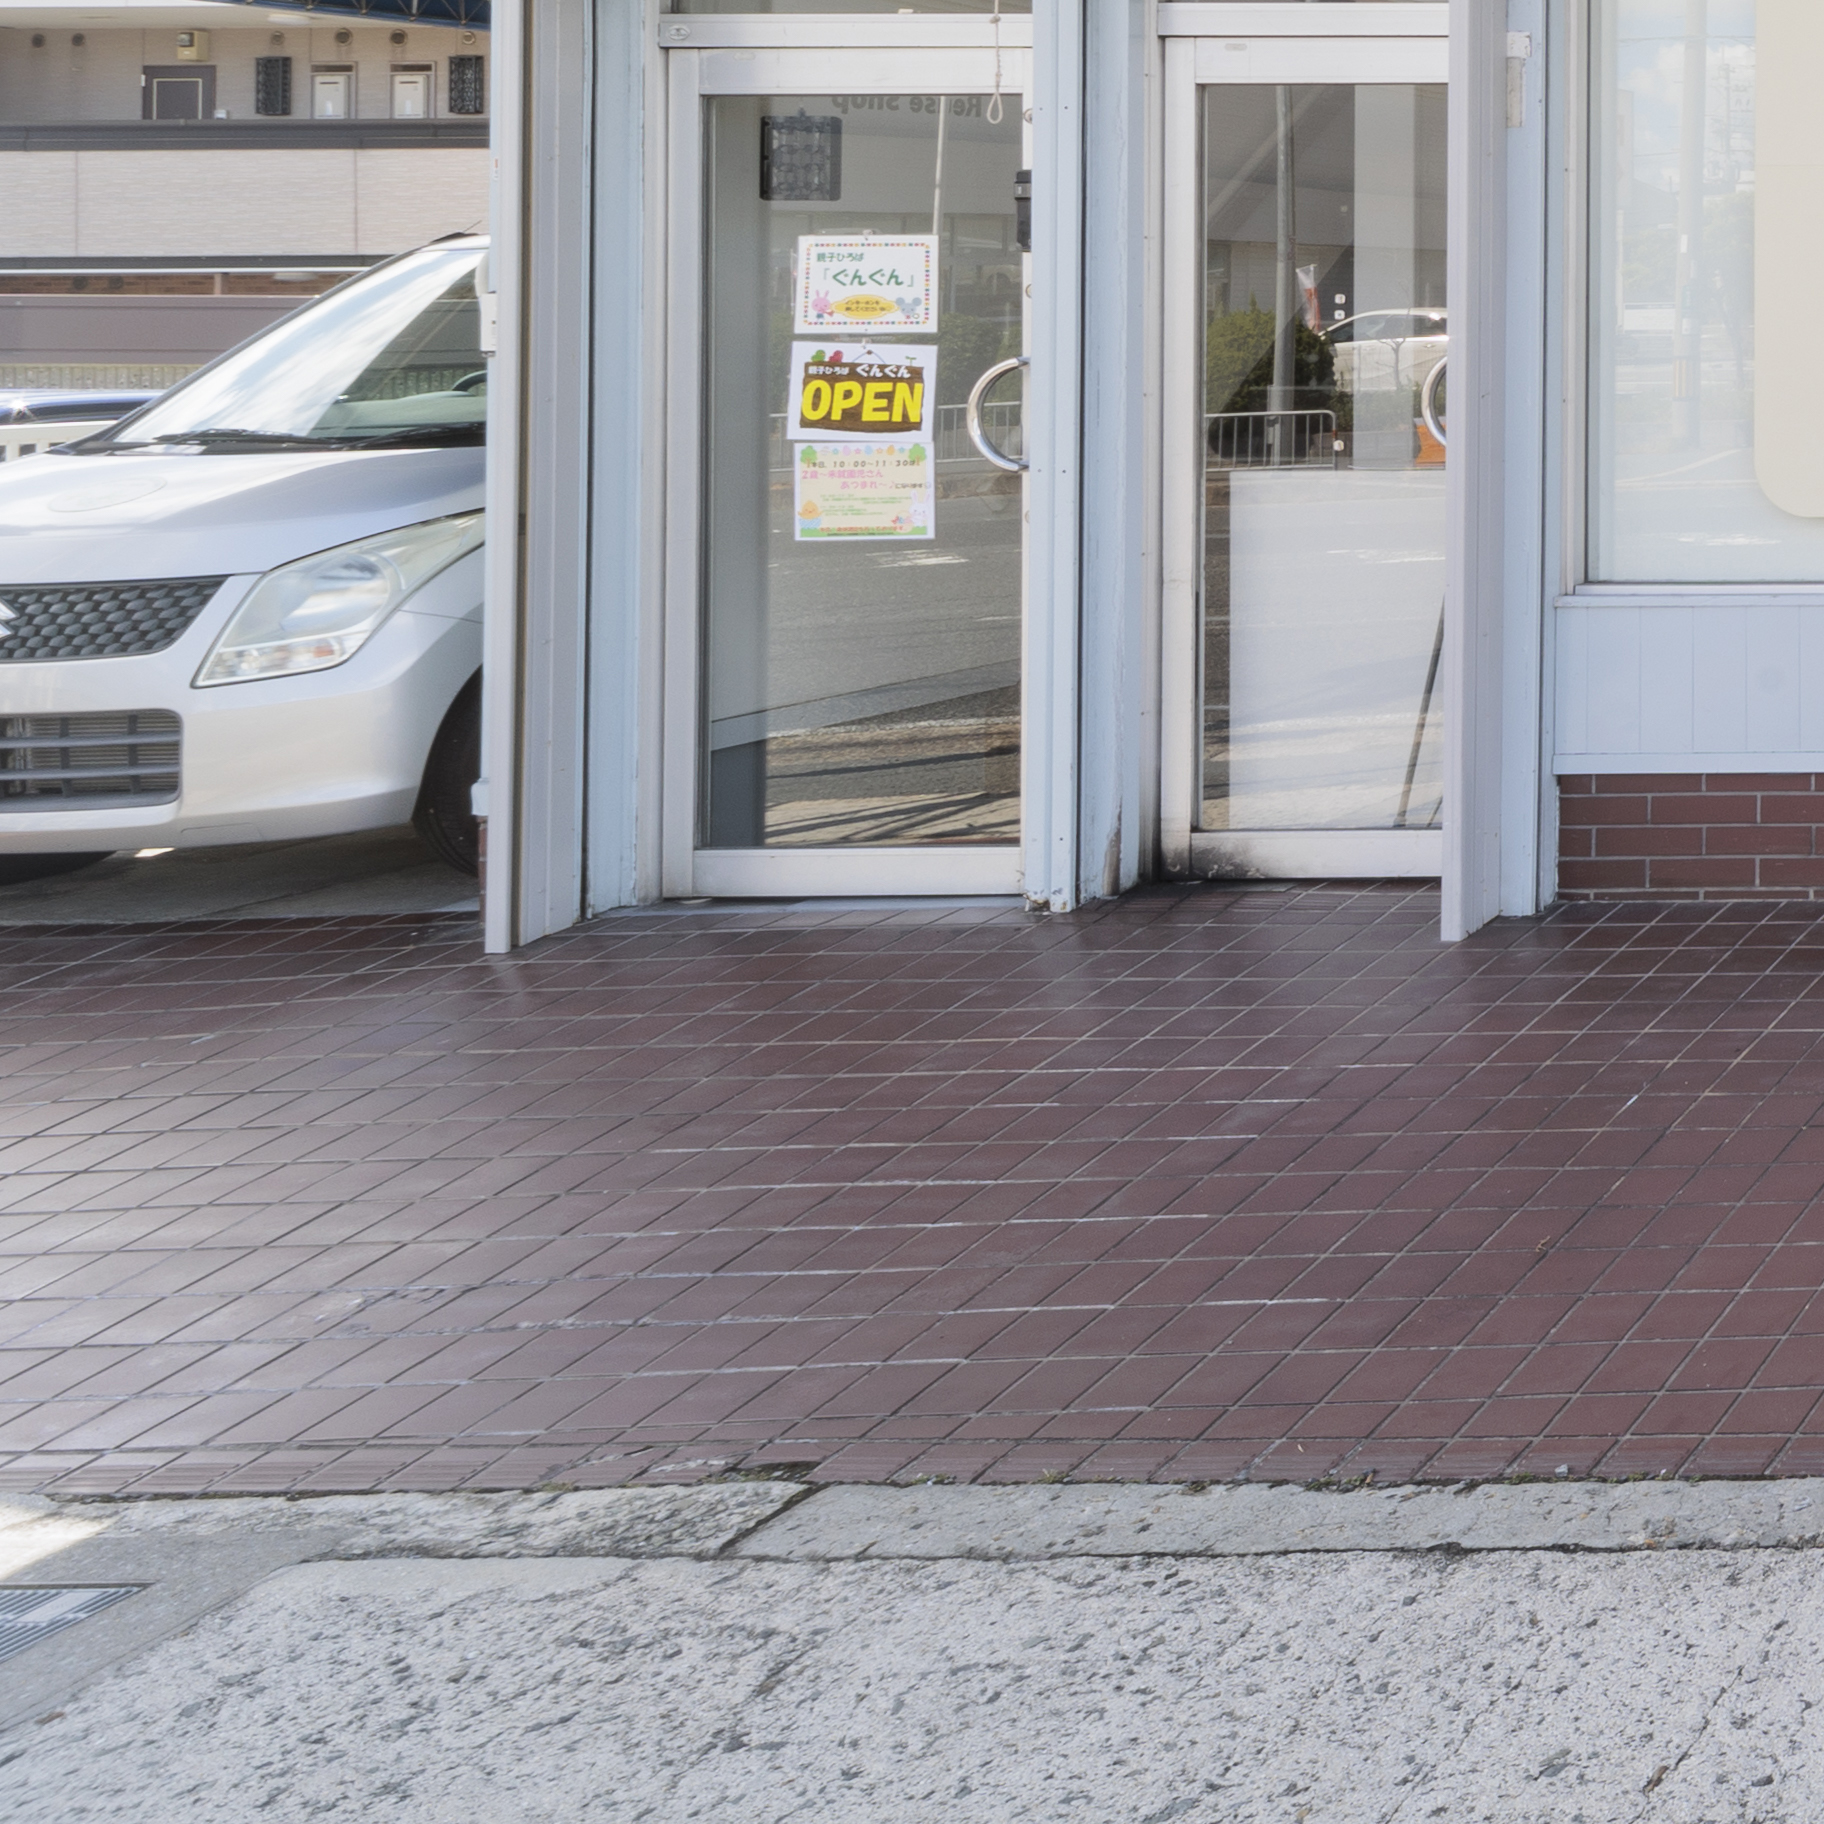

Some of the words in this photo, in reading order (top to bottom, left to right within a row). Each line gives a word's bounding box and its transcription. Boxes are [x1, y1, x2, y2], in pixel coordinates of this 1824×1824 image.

[856, 363, 911, 379] ぐんぐん
[801, 380, 924, 423] OPEN
